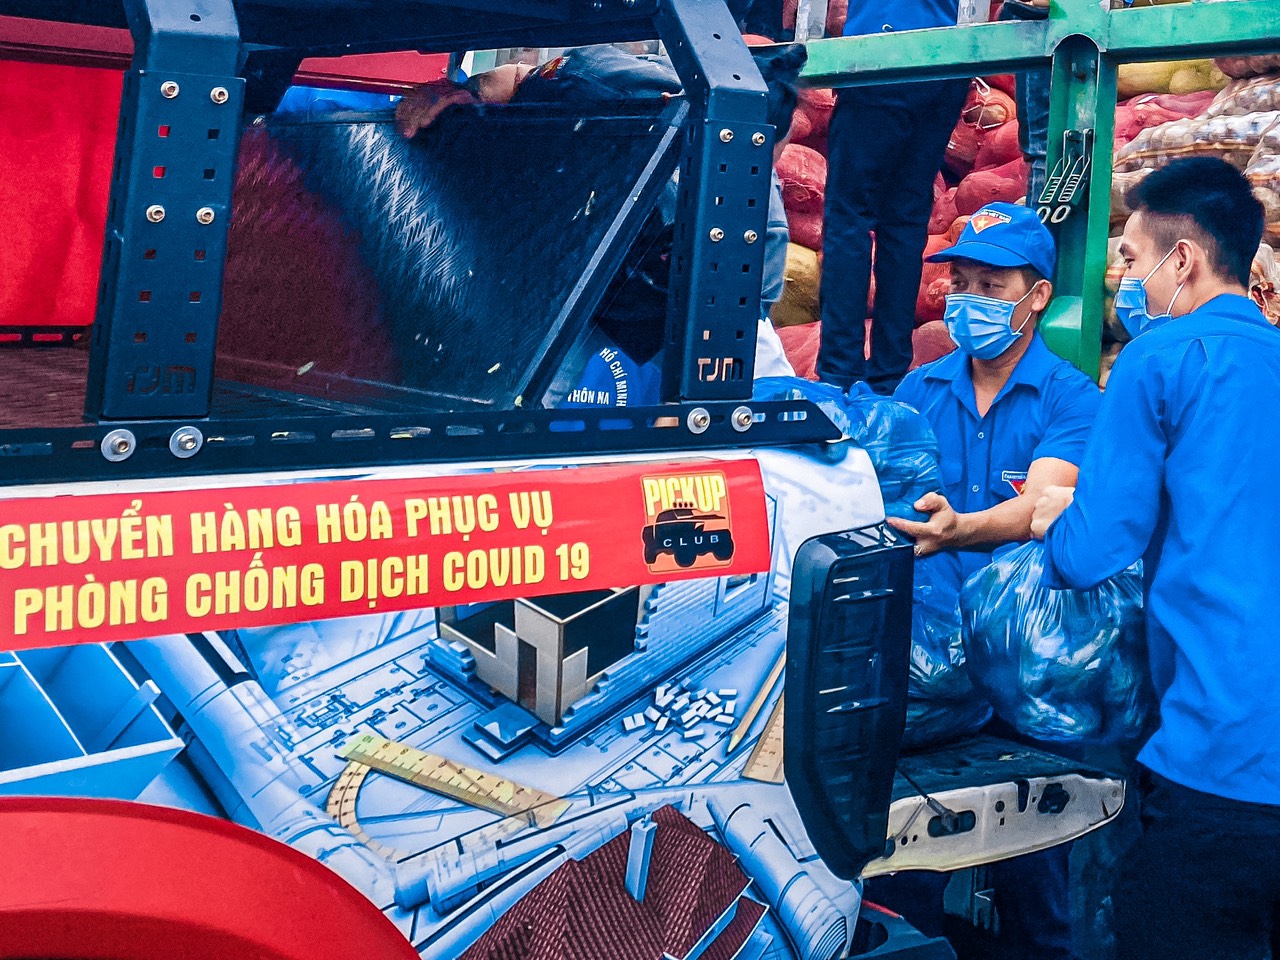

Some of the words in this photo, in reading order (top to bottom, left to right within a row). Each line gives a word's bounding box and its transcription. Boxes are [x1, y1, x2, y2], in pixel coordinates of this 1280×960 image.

[609, 360, 628, 380] CHÍ
[615, 379, 628, 407] MINH
[643, 475, 726, 516] PICKUP
[0, 499, 174, 569] CHUYỂN
[190, 502, 302, 554] HÀNG
[316, 495, 393, 544] HÓA
[405, 493, 500, 542] PHỤC
[509, 490, 554, 536] VỤ
[663, 534, 719, 548] CLUB
[13, 573, 168, 635] PHÒNG
[185, 551, 325, 618] CHỐNG
[340, 553, 430, 609] DỊCH
[443, 544, 545, 592] COVID
[555, 541, 590, 581] 19
